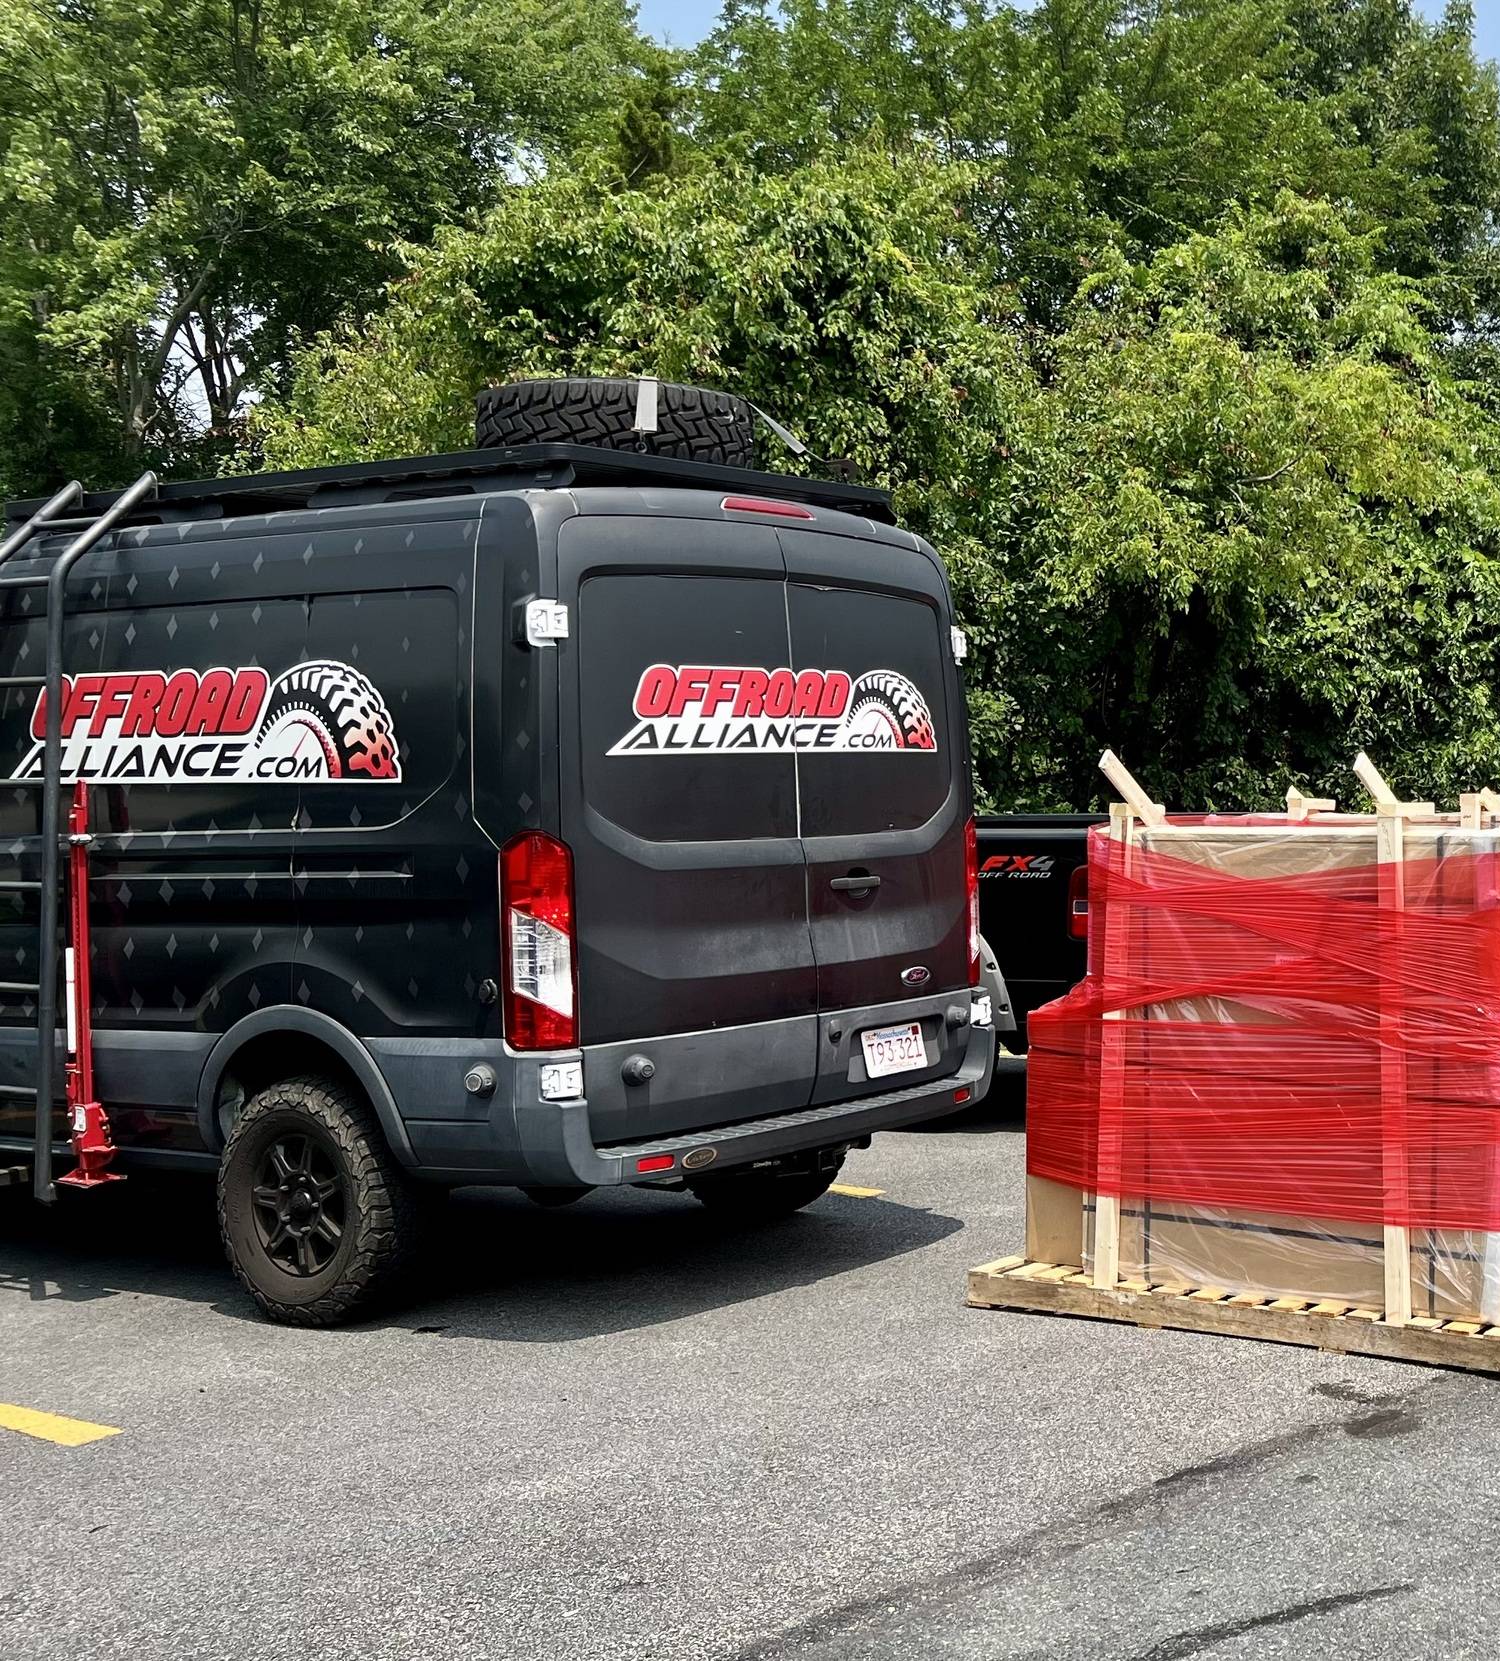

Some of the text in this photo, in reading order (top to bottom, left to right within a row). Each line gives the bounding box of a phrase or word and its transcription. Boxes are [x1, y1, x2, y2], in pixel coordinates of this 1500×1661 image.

[32, 669, 268, 738] OFFROAD
[635, 667, 850, 718] OFFROAD
[620, 723, 843, 750] ALLIANCE
[977, 871, 1052, 879] OFF ROAD
[980, 855, 1055, 871] FX4
